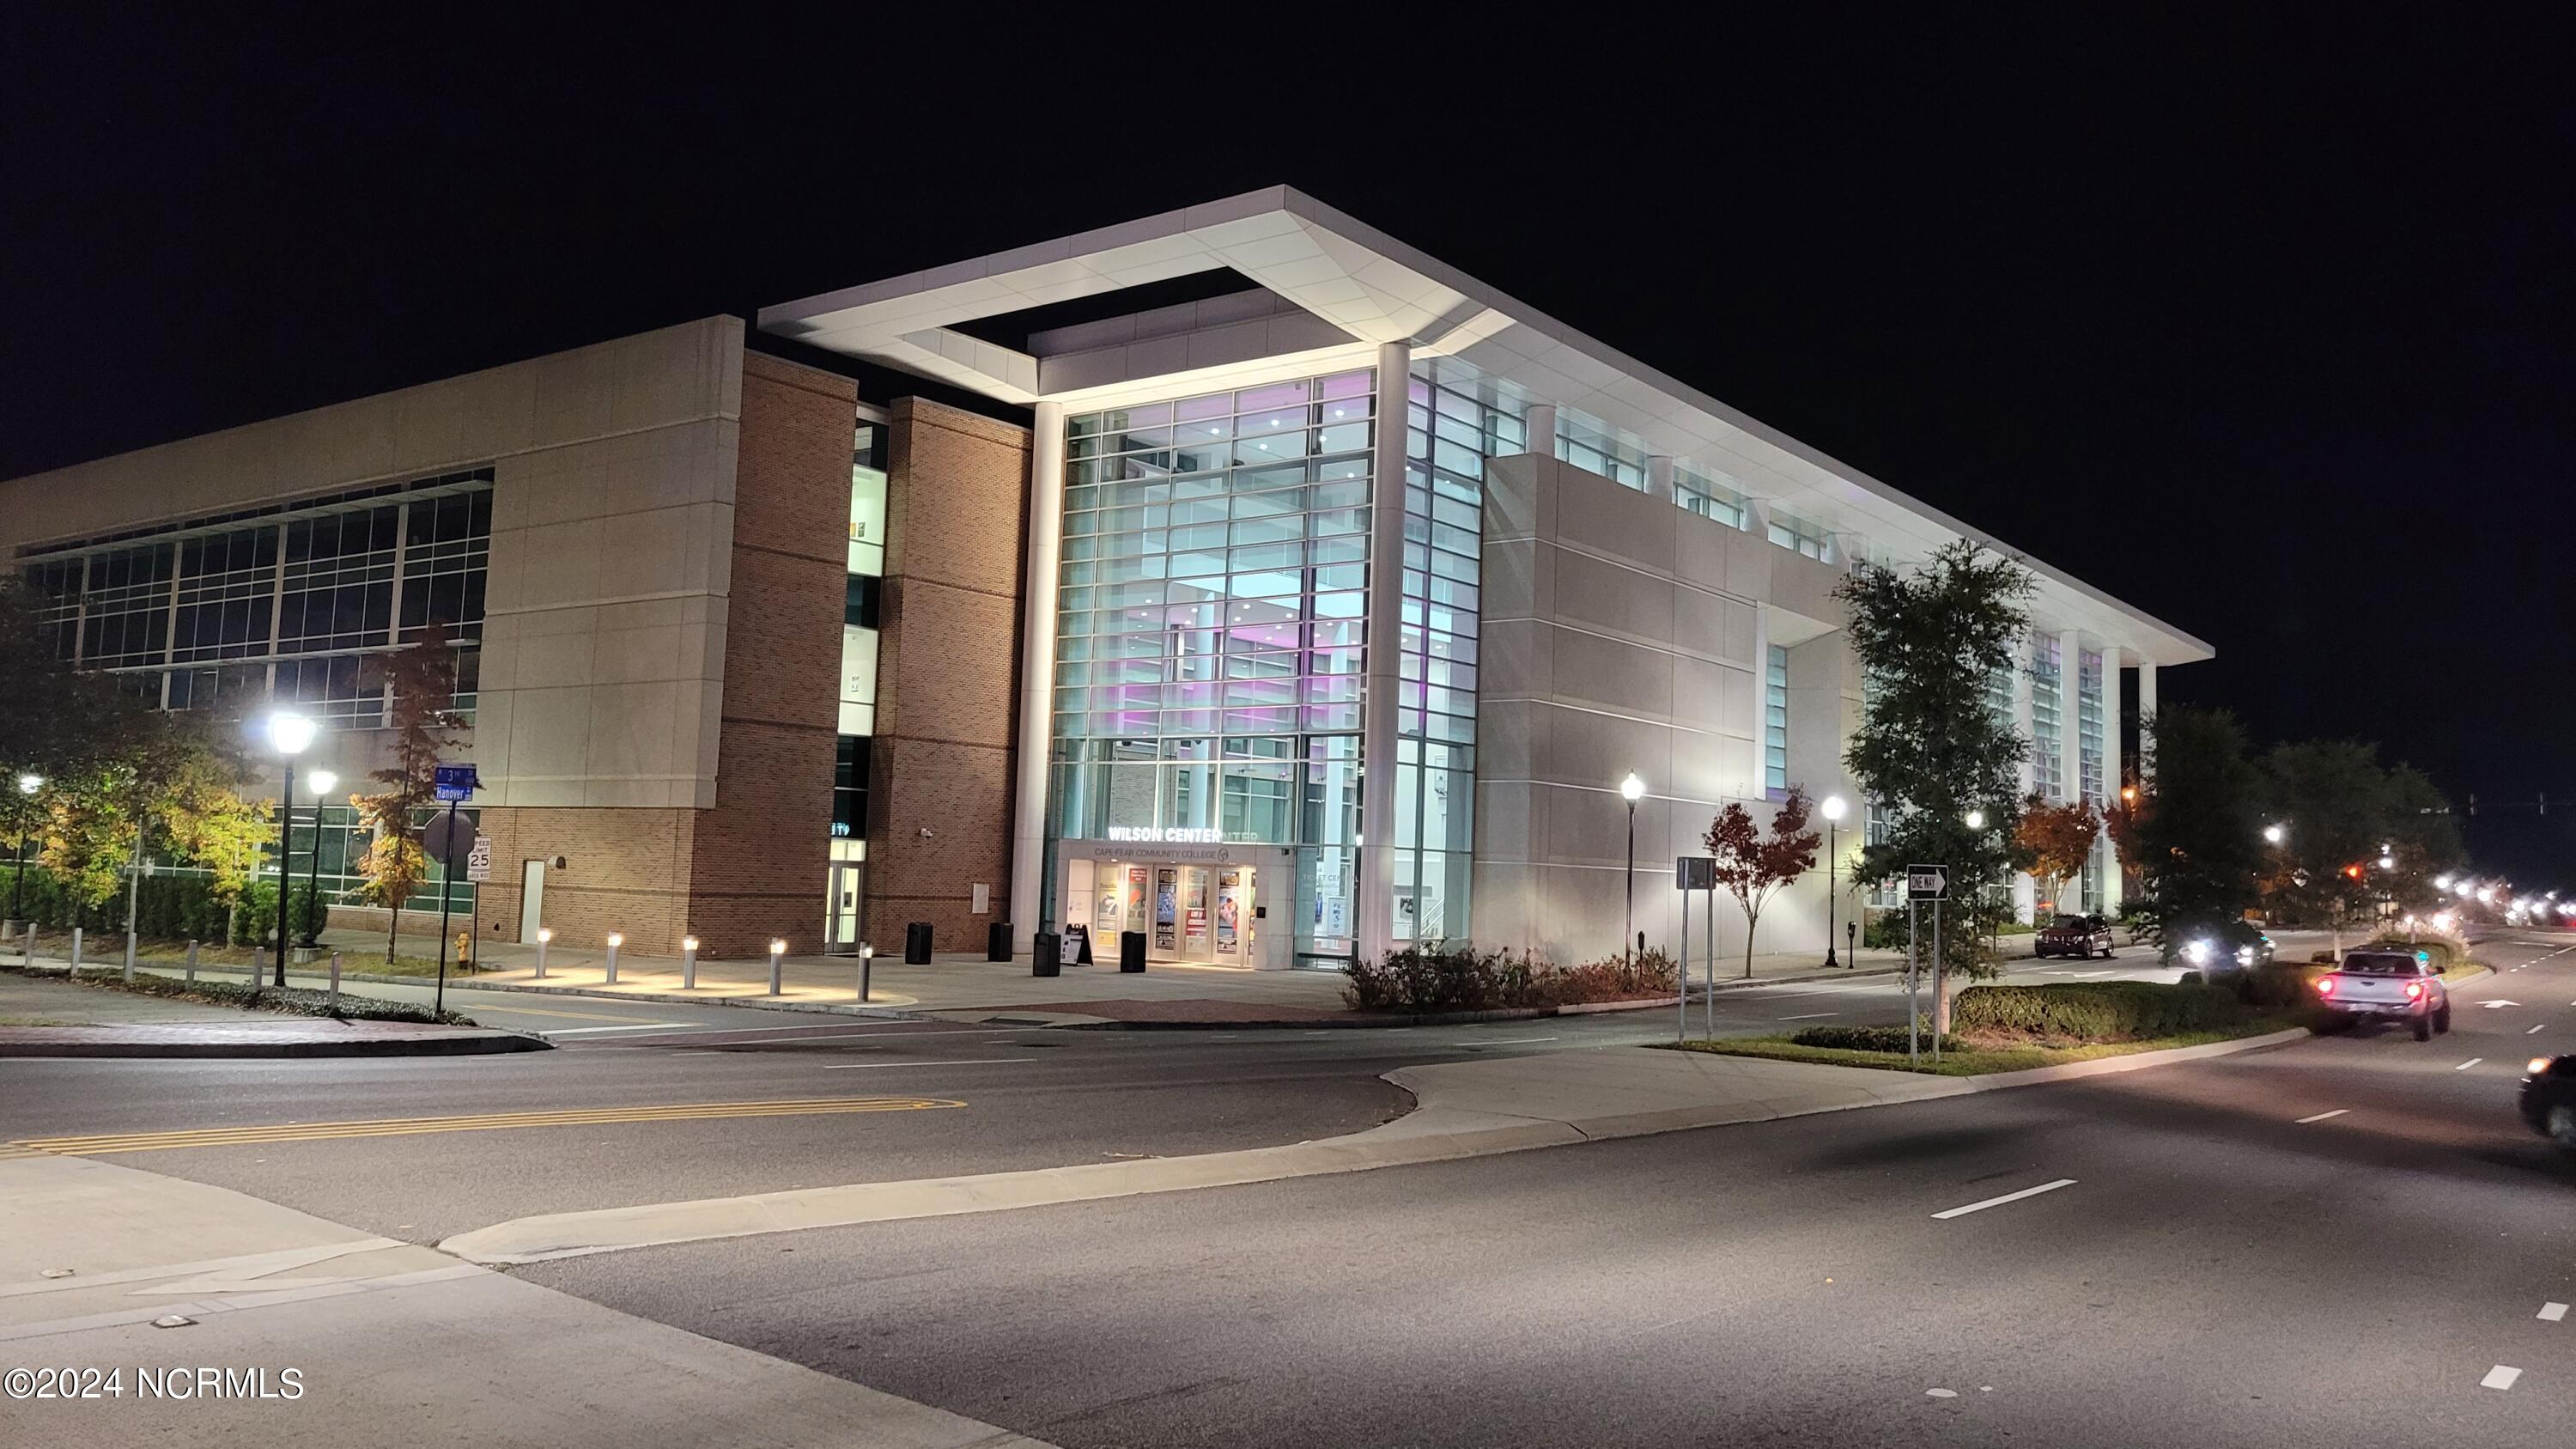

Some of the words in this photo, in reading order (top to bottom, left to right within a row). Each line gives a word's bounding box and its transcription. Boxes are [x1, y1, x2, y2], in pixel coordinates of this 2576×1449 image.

[436, 786, 464, 799] Hanover
[1109, 827, 1163, 842] WILSON
[1165, 828, 1221, 843] CENTER
[1094, 848, 1114, 856] CAPE
[1115, 849, 1133, 857] FEAR
[1135, 849, 1181, 858] COMMUNITY
[1182, 849, 1216, 859] COLLEGE
[471, 855, 489, 867] 25
[1911, 876, 1923, 889] ONE
[1923, 876, 1936, 888] WAY
